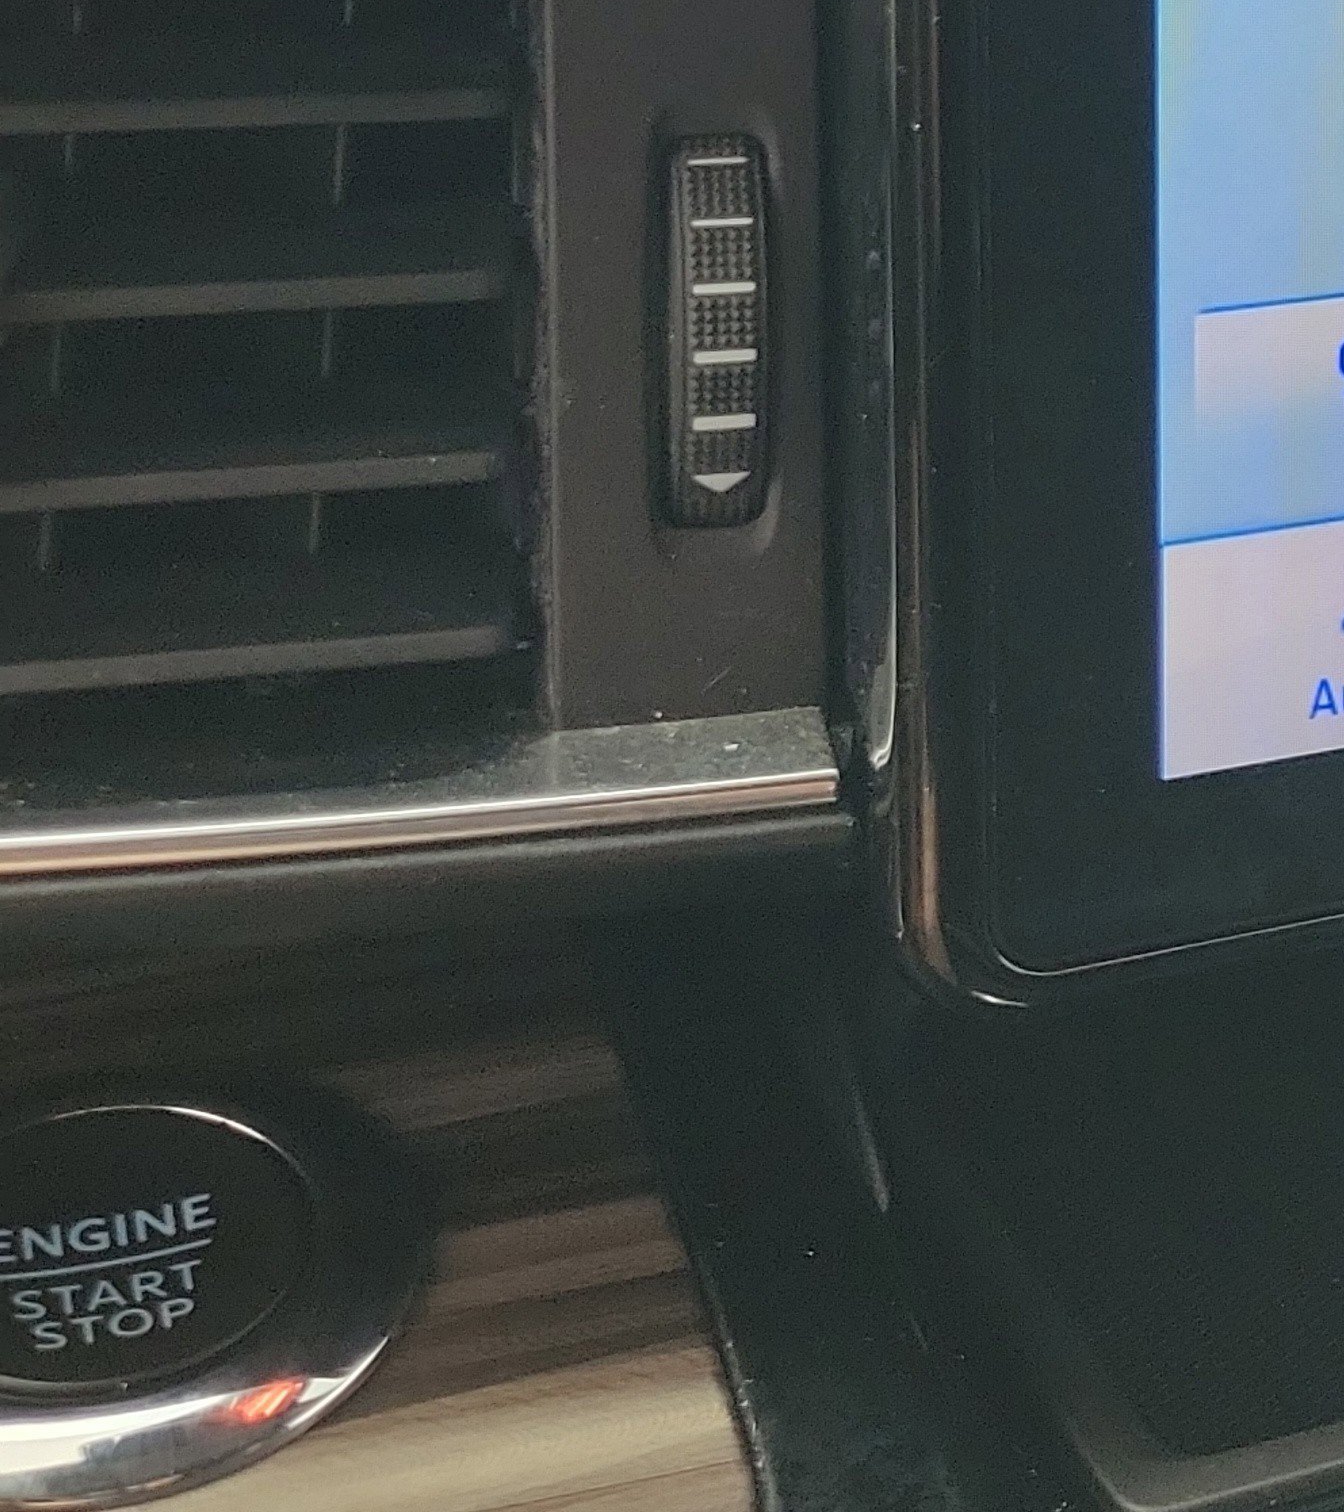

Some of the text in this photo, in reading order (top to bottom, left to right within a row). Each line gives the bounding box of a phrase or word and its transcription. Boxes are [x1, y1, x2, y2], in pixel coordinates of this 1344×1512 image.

[0, 1192, 217, 1263] ENGINE
[12, 1259, 203, 1320] START
[33, 1297, 195, 1351] STOP
